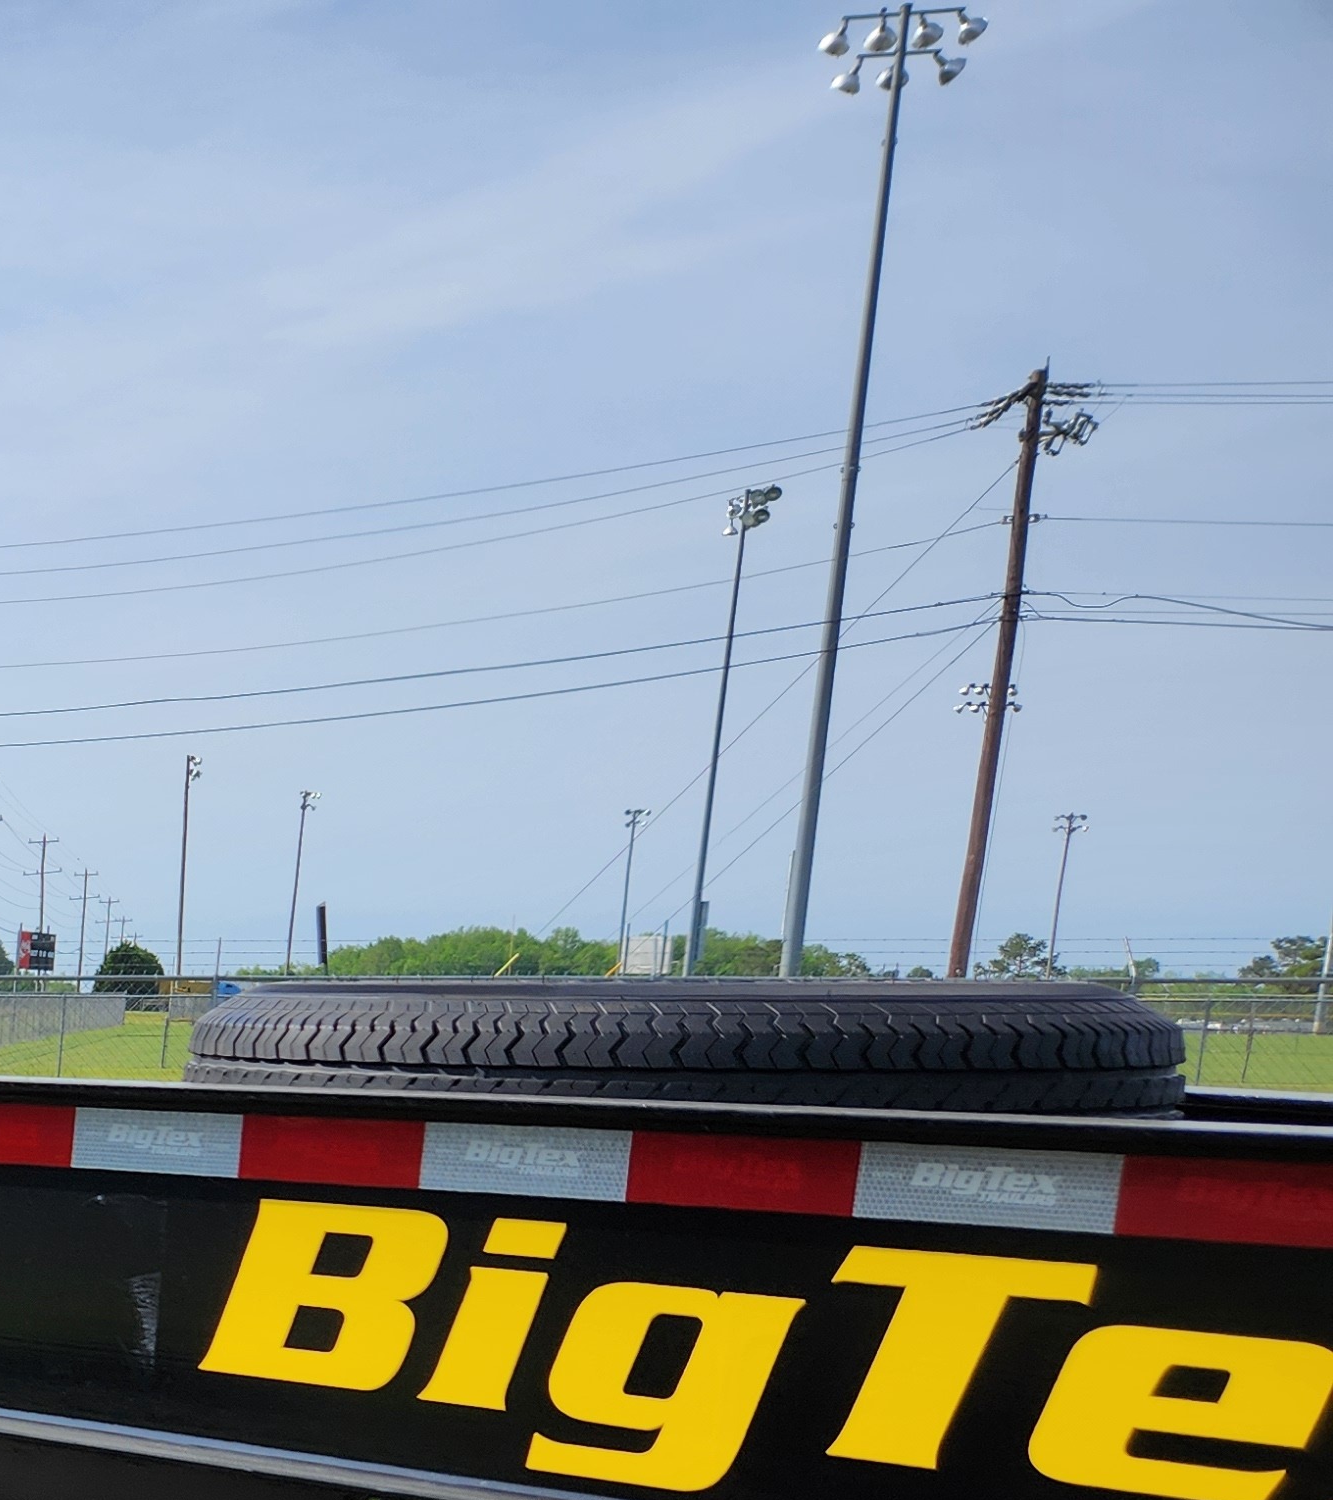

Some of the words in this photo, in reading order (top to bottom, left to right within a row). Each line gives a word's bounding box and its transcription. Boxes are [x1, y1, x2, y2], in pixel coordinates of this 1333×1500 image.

[107, 1123, 204, 1149] BigTex
[466, 1139, 583, 1169] BigTex
[910, 1161, 1062, 1195] BigTex
